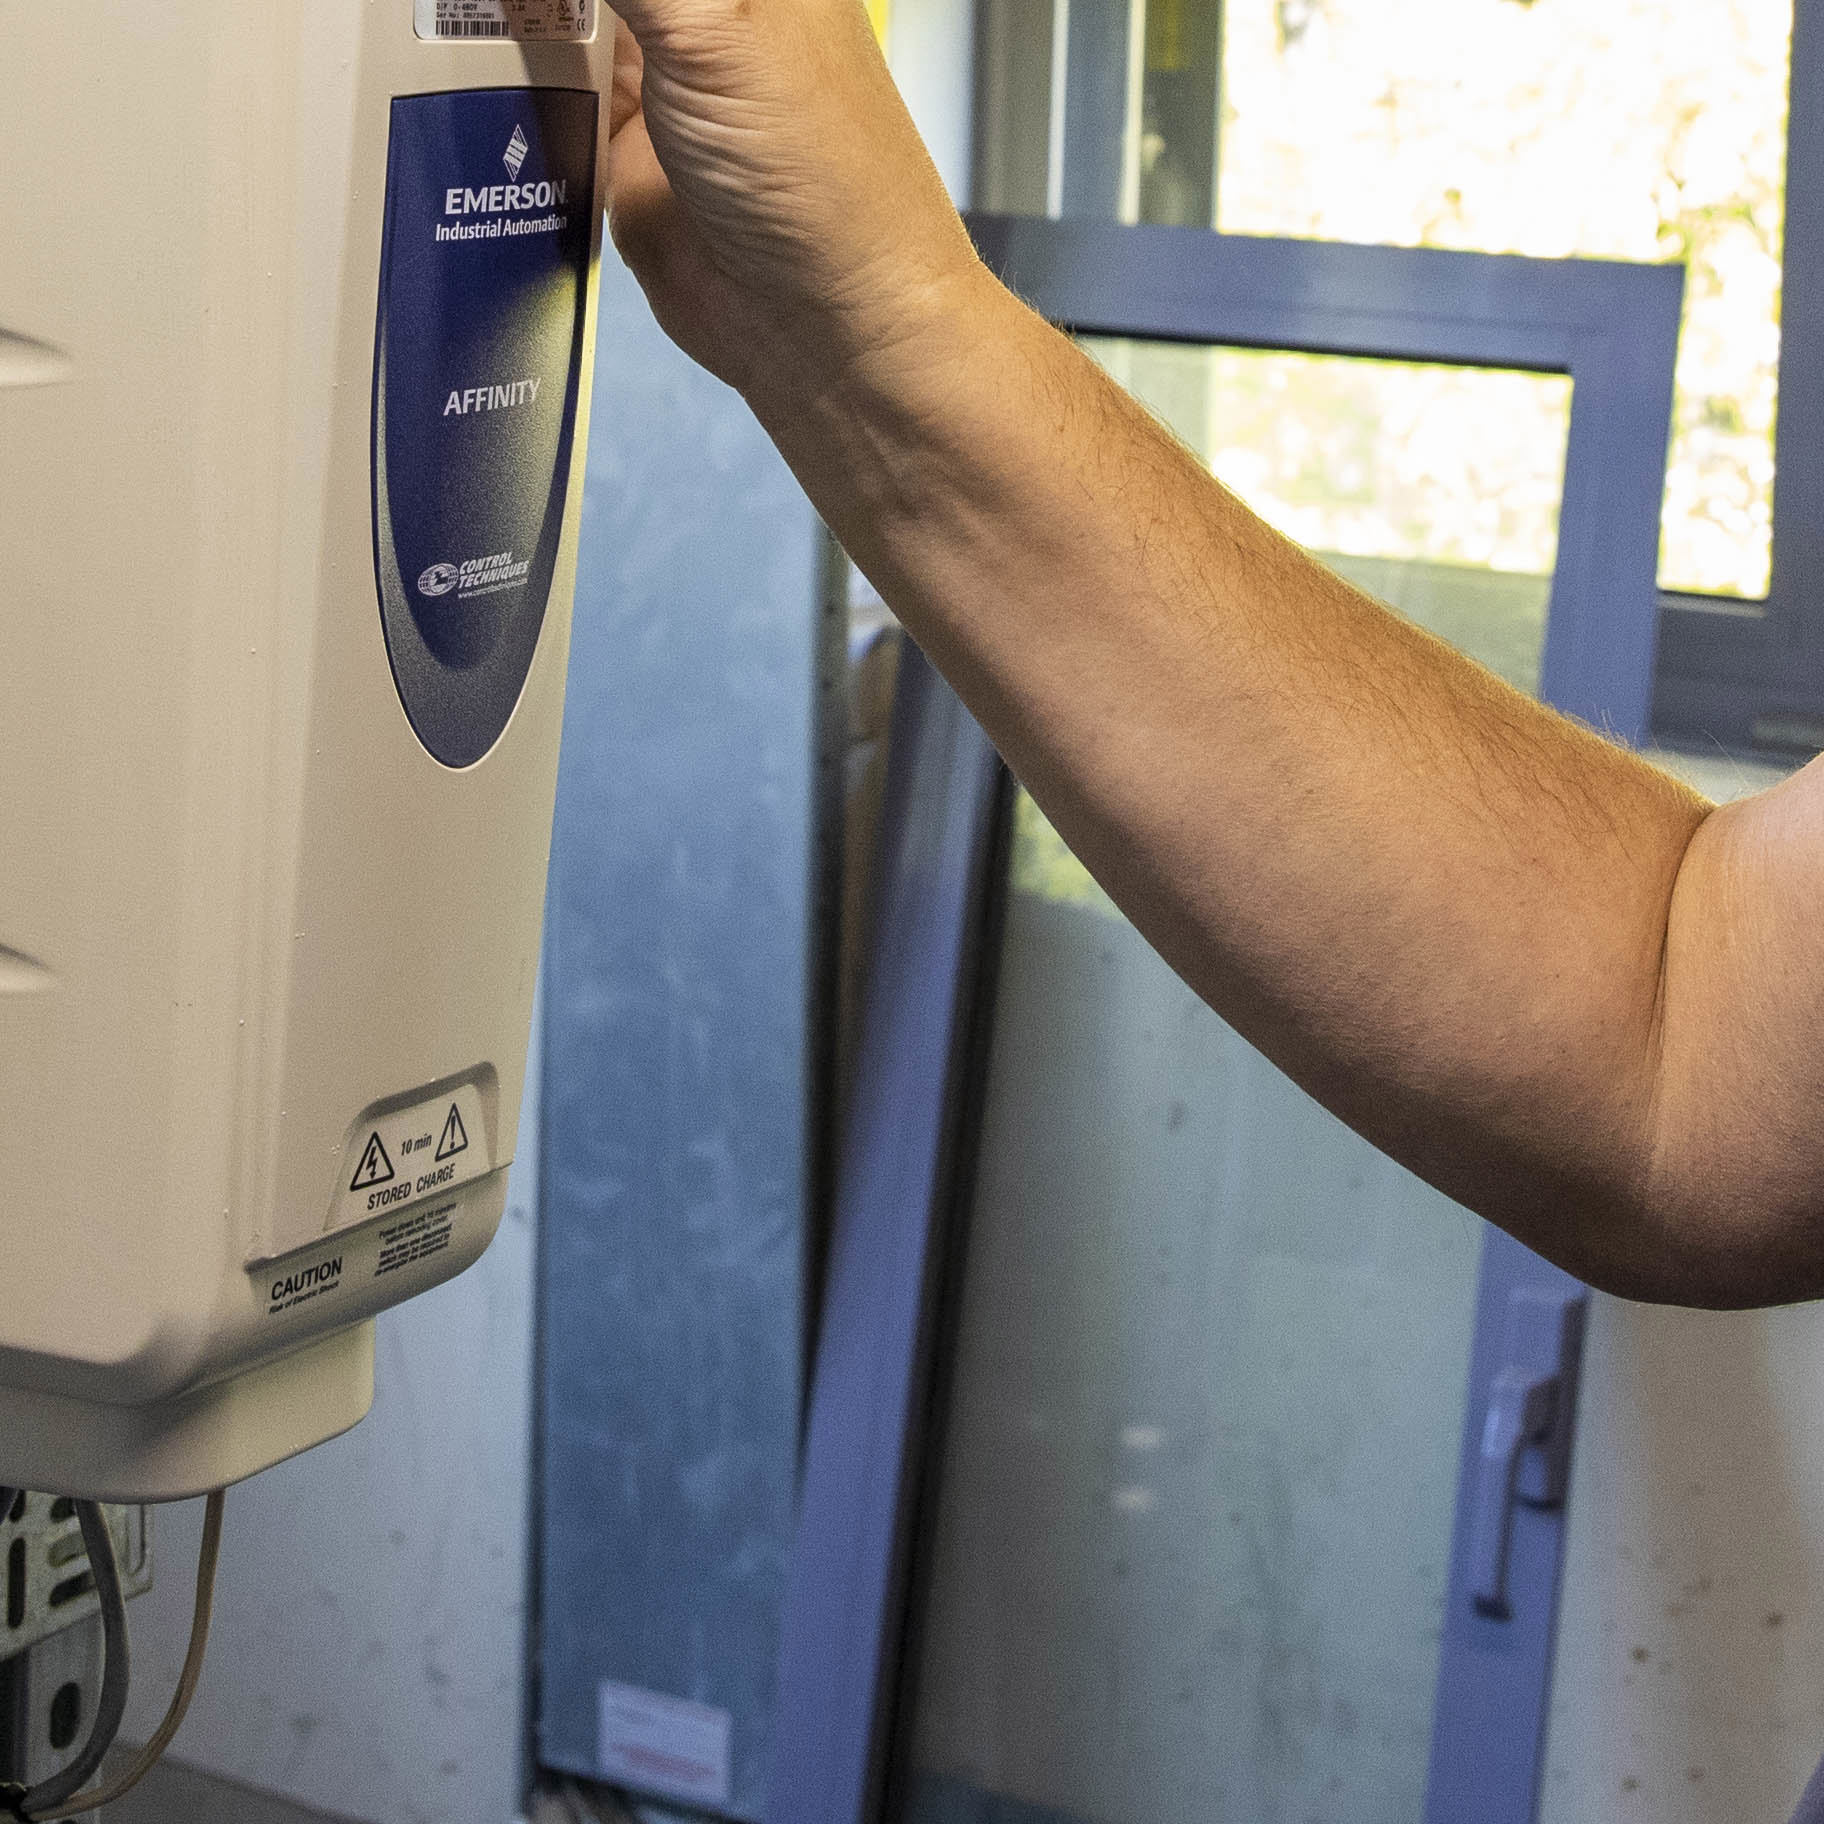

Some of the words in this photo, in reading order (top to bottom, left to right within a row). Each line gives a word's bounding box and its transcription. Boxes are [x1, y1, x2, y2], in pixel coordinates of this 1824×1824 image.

[444, 179, 568, 215] EMERSON
[435, 218, 502, 241] Industrial
[503, 213, 568, 237] Automation
[443, 378, 541, 417] AFFINITY
[458, 560, 530, 590] TECHNIQUES
[459, 551, 513, 575] CONTROL
[401, 1139, 413, 1156] 10
[413, 1132, 433, 1152] min
[367, 1181, 412, 1210] STORED
[416, 1163, 456, 1193] CHARGE
[271, 1256, 343, 1301] CAUTION
